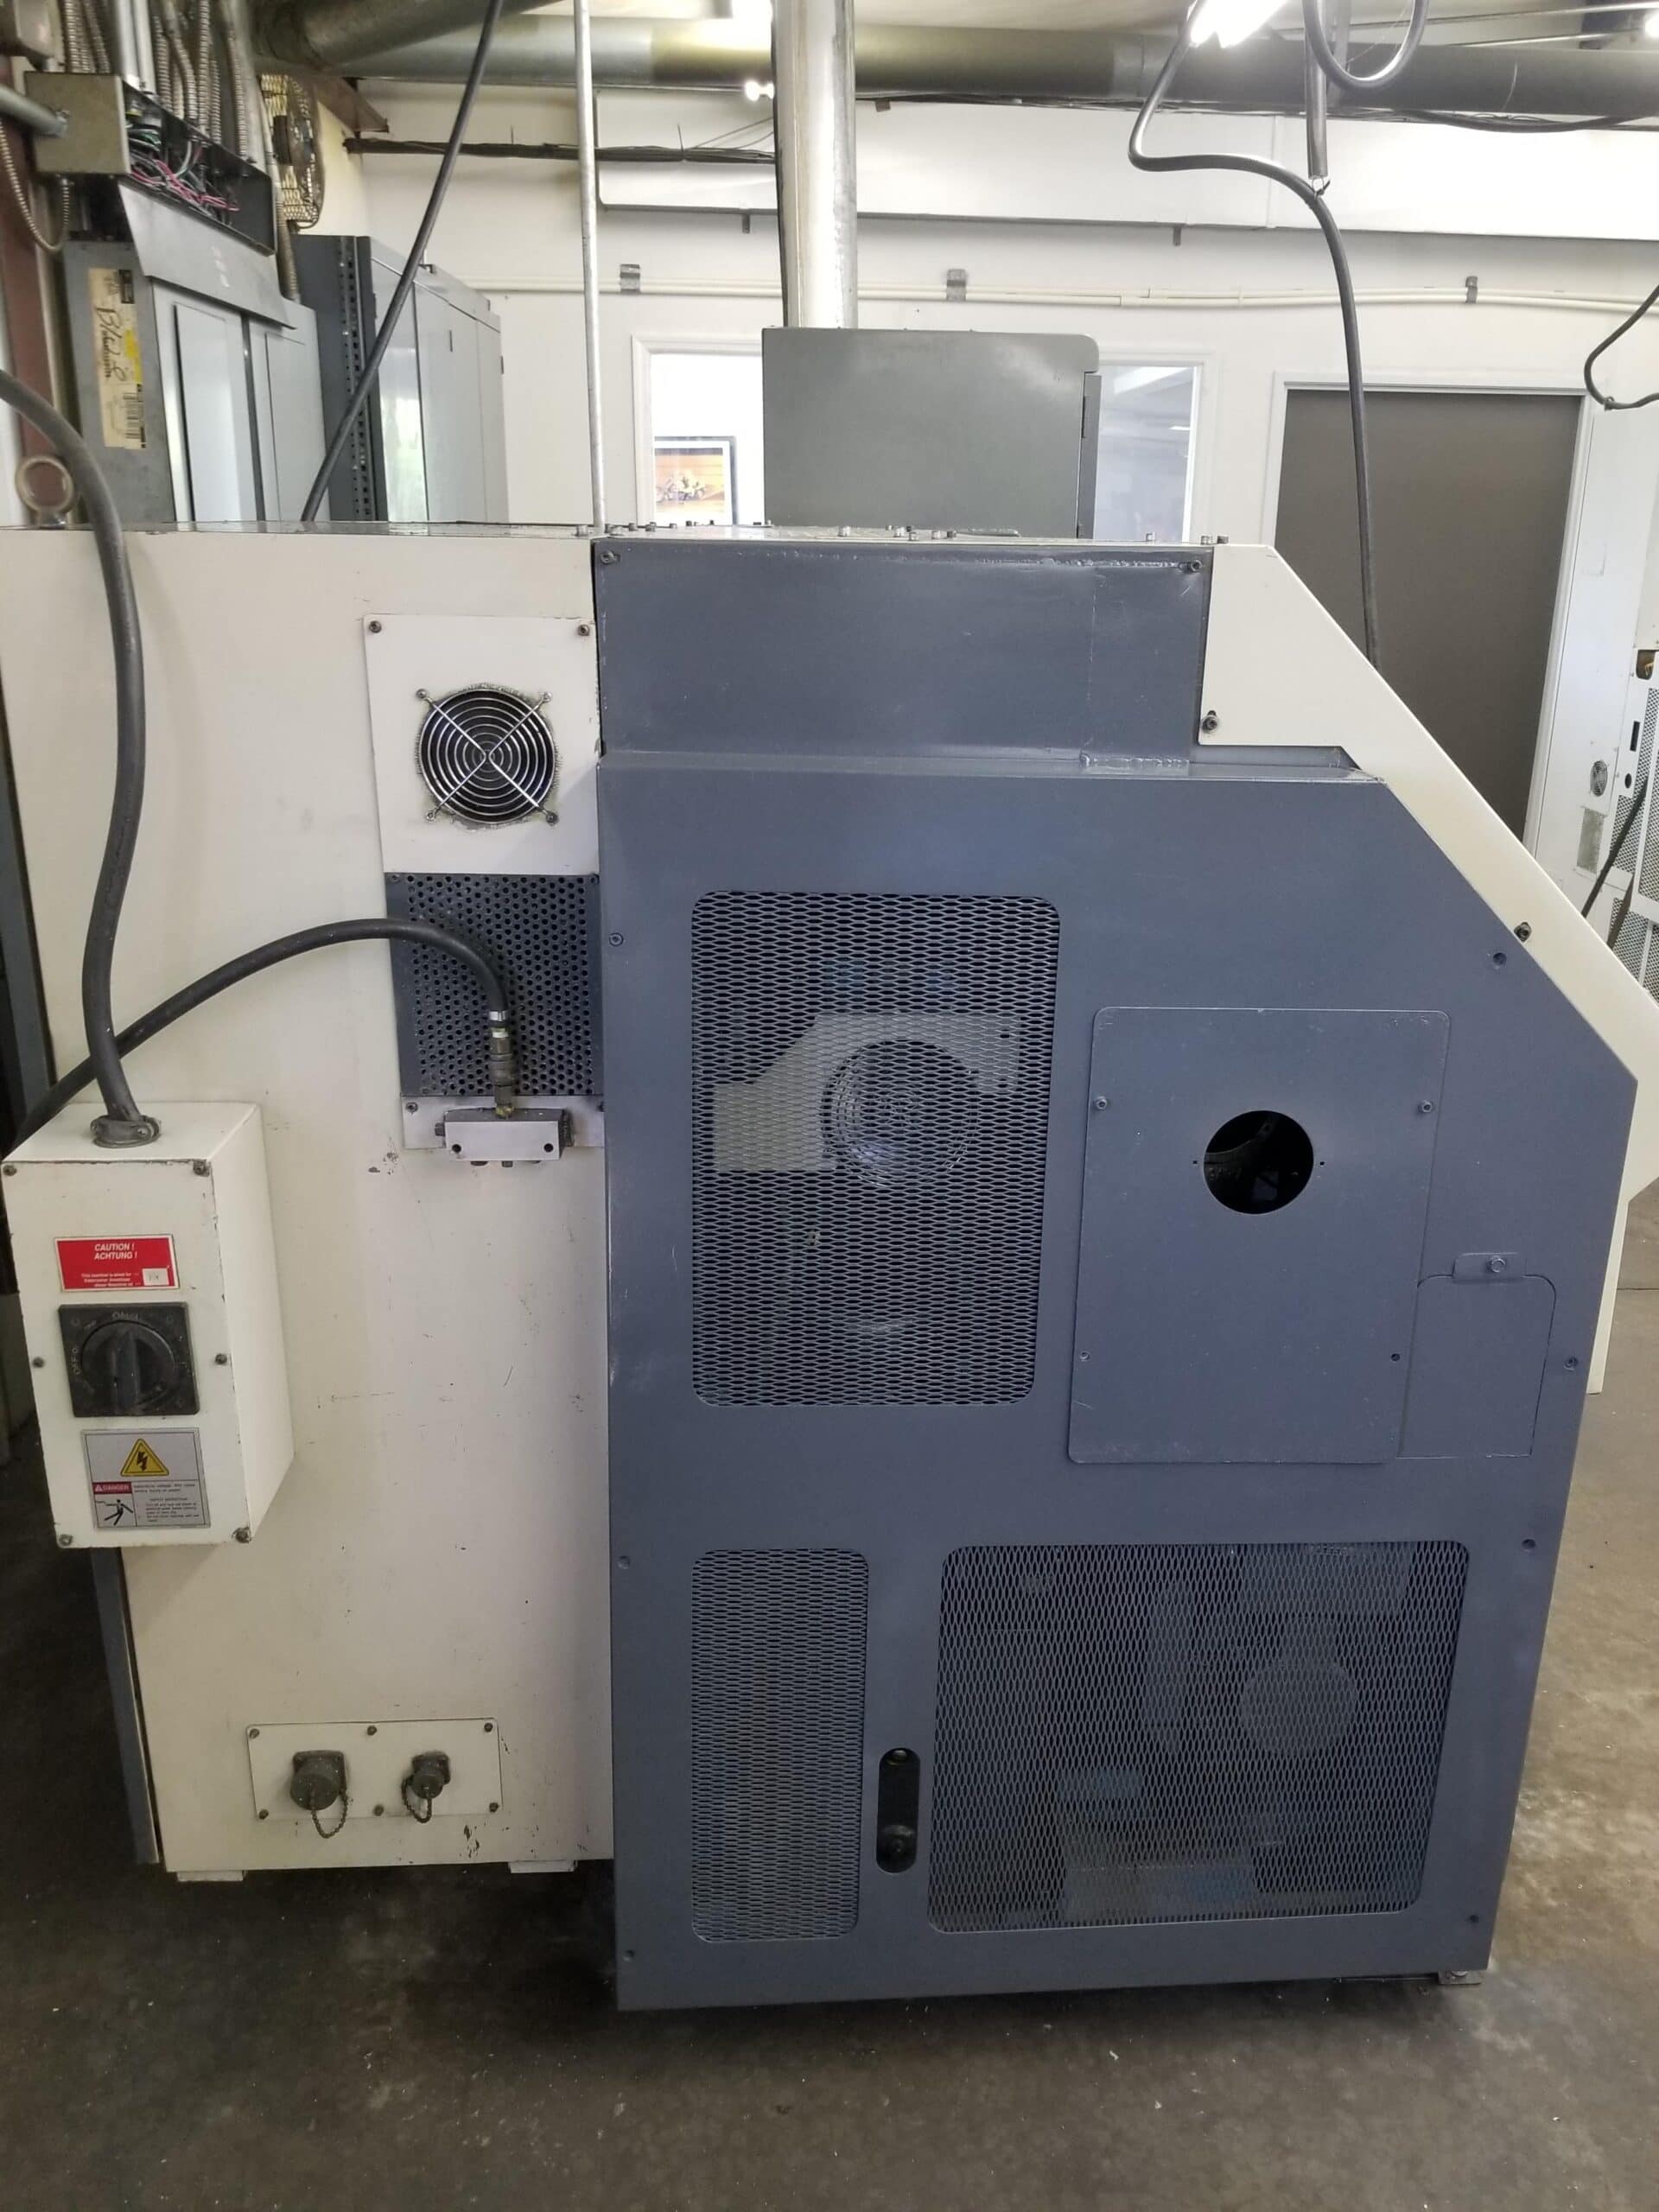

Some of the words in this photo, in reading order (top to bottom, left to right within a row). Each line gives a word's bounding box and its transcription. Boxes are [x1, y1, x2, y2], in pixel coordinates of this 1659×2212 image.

[93, 1243, 130, 1252] CAUTION
[93, 1251, 134, 1261] ACHTUNG
[103, 1484, 130, 1492] DANGER
